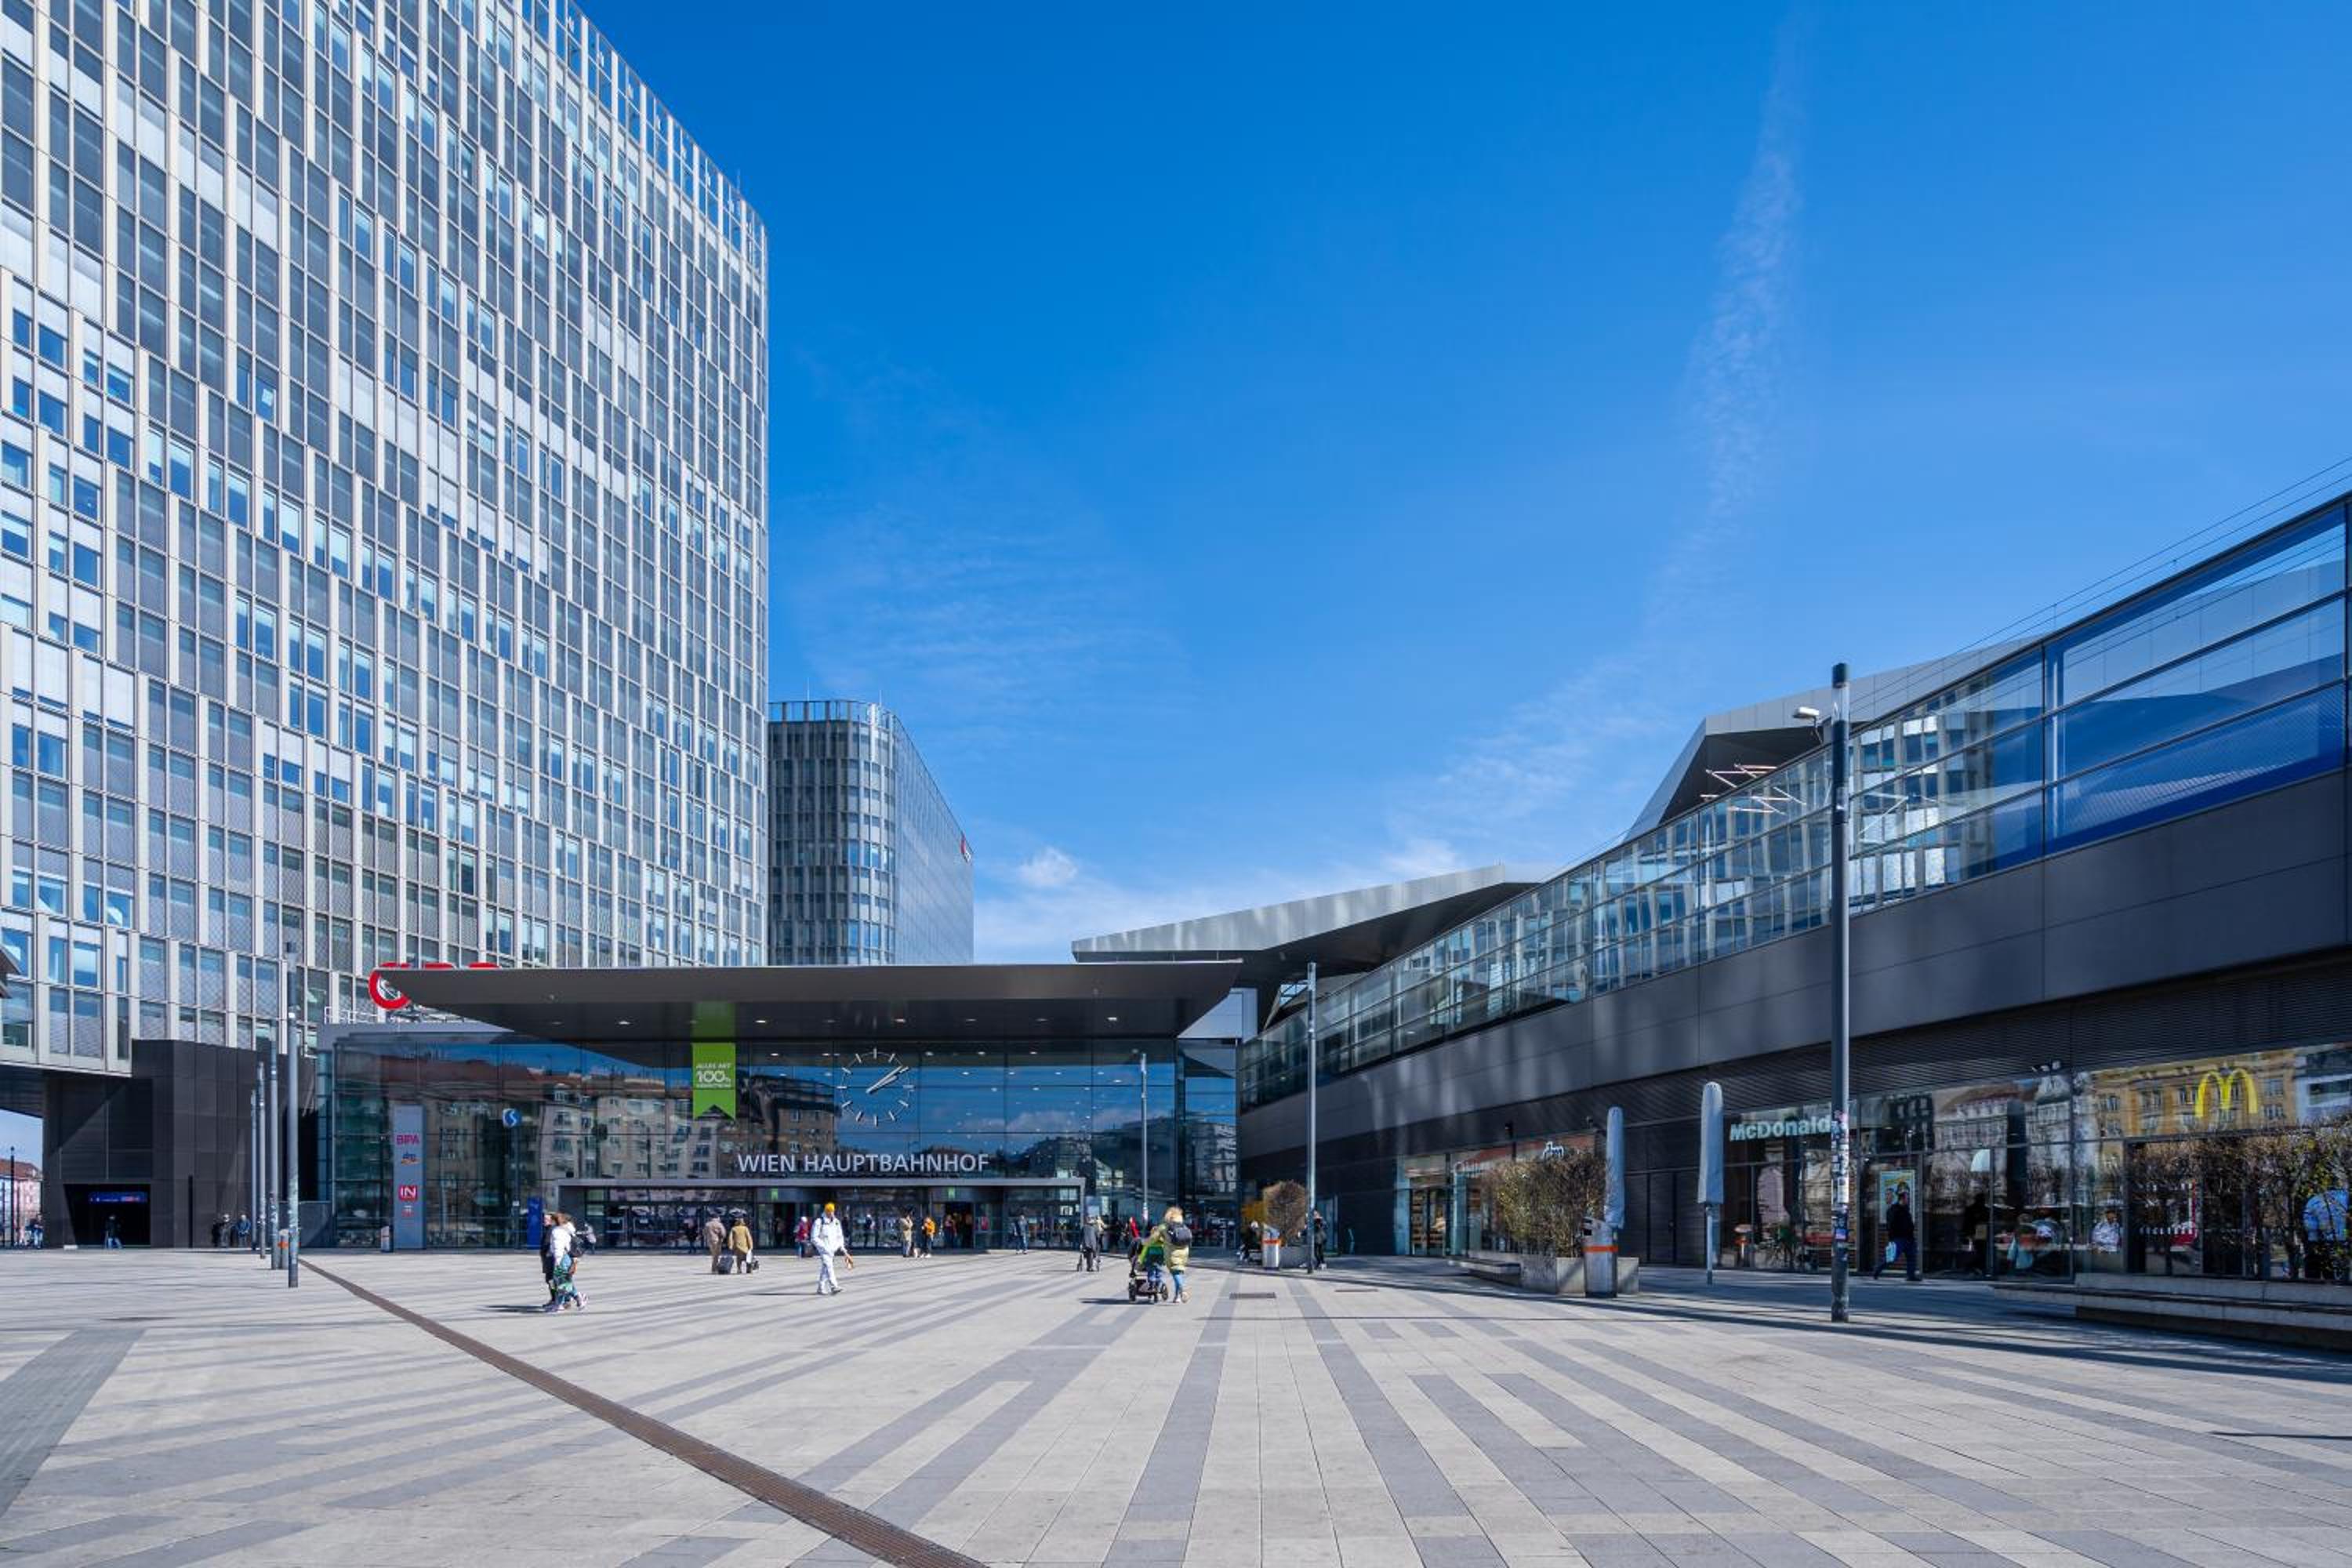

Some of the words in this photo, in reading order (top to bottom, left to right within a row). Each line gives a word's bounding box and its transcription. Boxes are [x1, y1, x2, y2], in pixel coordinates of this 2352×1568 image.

[1730, 1114, 1831, 1142] McDonald
[396, 1134, 419, 1145] BIPA
[737, 1153, 795, 1172] WIEN
[804, 1153, 989, 1172] HAUPTBAHNHOF
